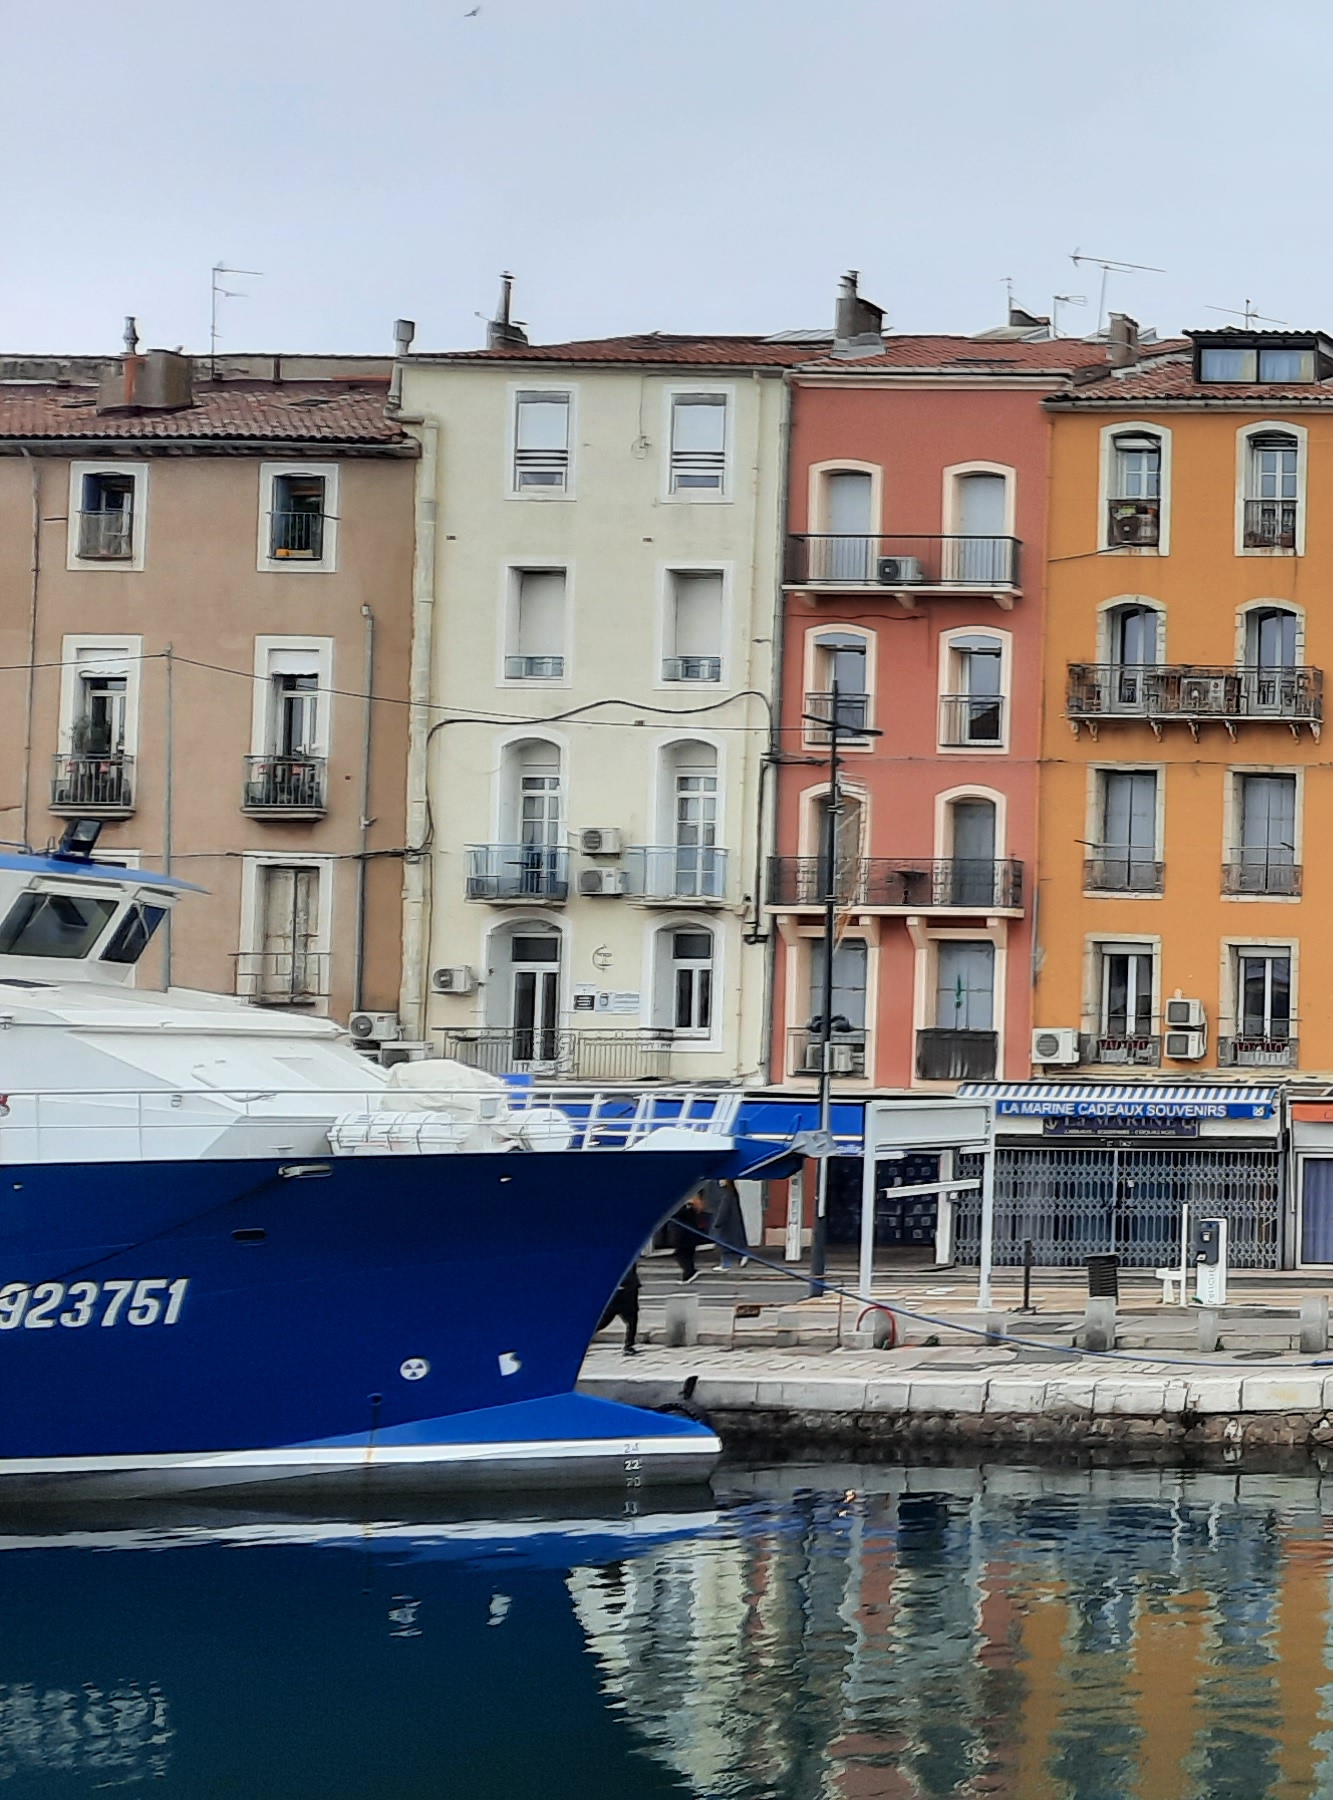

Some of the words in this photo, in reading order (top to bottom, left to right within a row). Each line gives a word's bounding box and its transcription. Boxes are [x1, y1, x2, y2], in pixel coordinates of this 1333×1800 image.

[1001, 1103, 1019, 1114] LA
[1021, 1103, 1075, 1115] MARINE
[1078, 1103, 1144, 1116] CADEAUX
[1146, 1104, 1227, 1117] SOUVENIRS
[0, 1277, 189, 1330] 923751
[624, 1459, 641, 1471] 22
